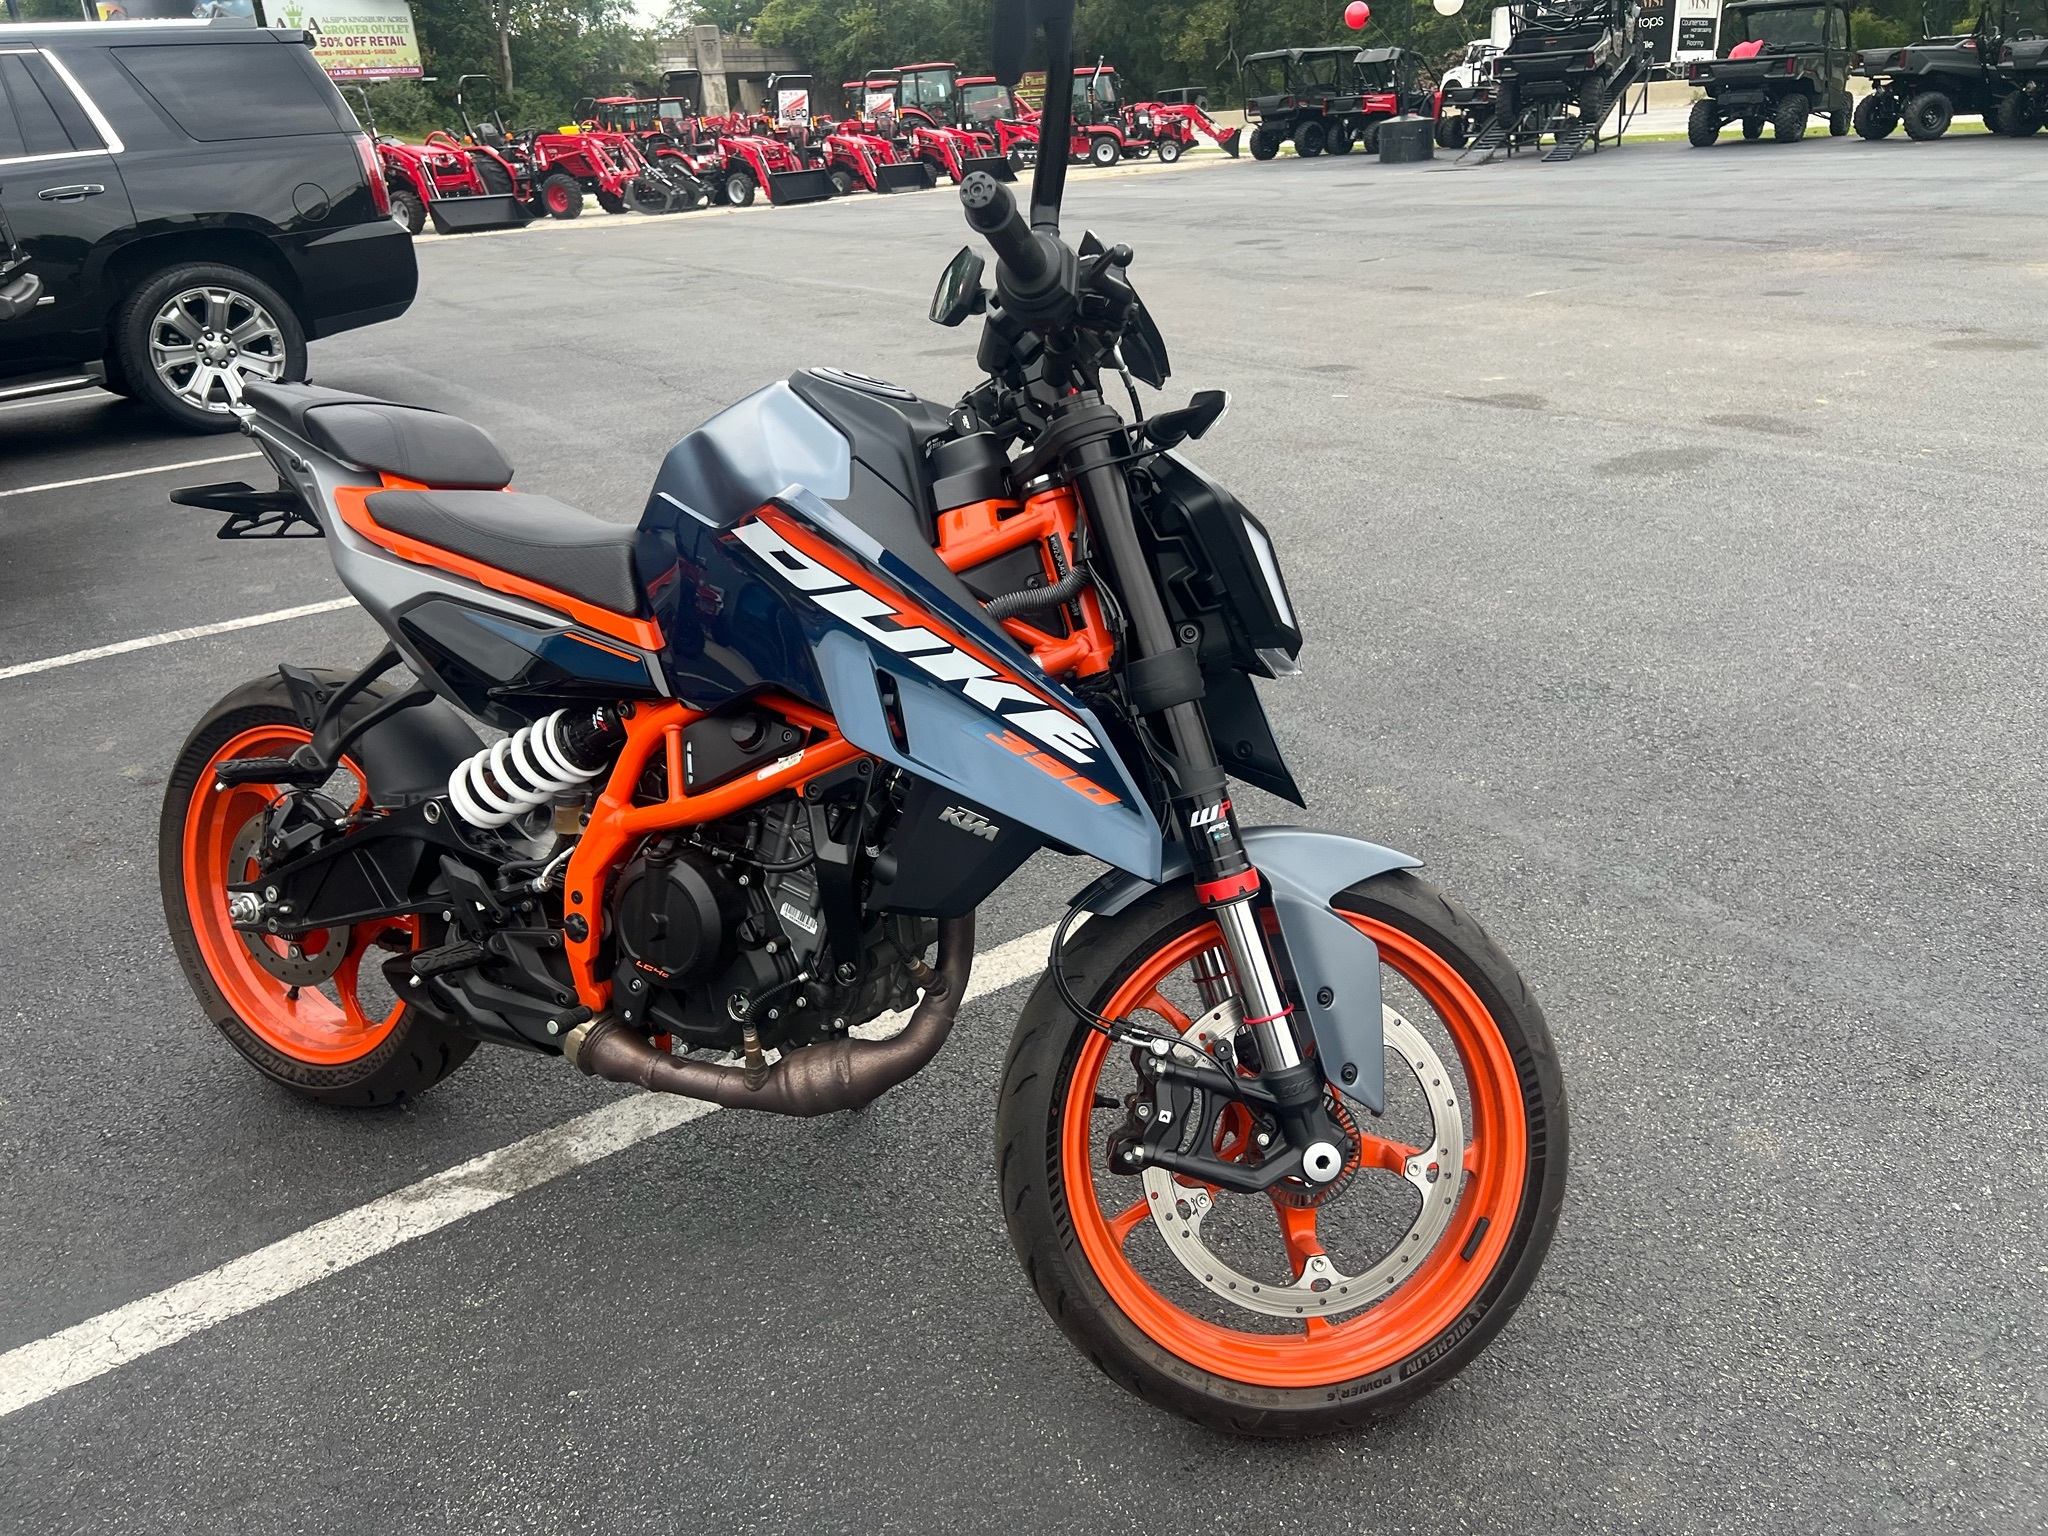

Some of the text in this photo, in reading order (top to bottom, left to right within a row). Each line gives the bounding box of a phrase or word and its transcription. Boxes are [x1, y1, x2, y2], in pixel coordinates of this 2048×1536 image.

[320, 36, 407, 48] 50% OFF RETAIL
[323, 24, 410, 35] GROWER OUTLET
[780, 108, 808, 121] VALPO
[730, 515, 1101, 764] DUKE
[985, 729, 1122, 806] 390
[938, 805, 1000, 842] KTM
[1190, 799, 1231, 828] WP
[1206, 820, 1230, 835] APEX
[226, 1022, 292, 1077] MICHELIN
[1405, 1318, 1473, 1376] MICHELIN
[1327, 1375, 1392, 1402] POWER 6
